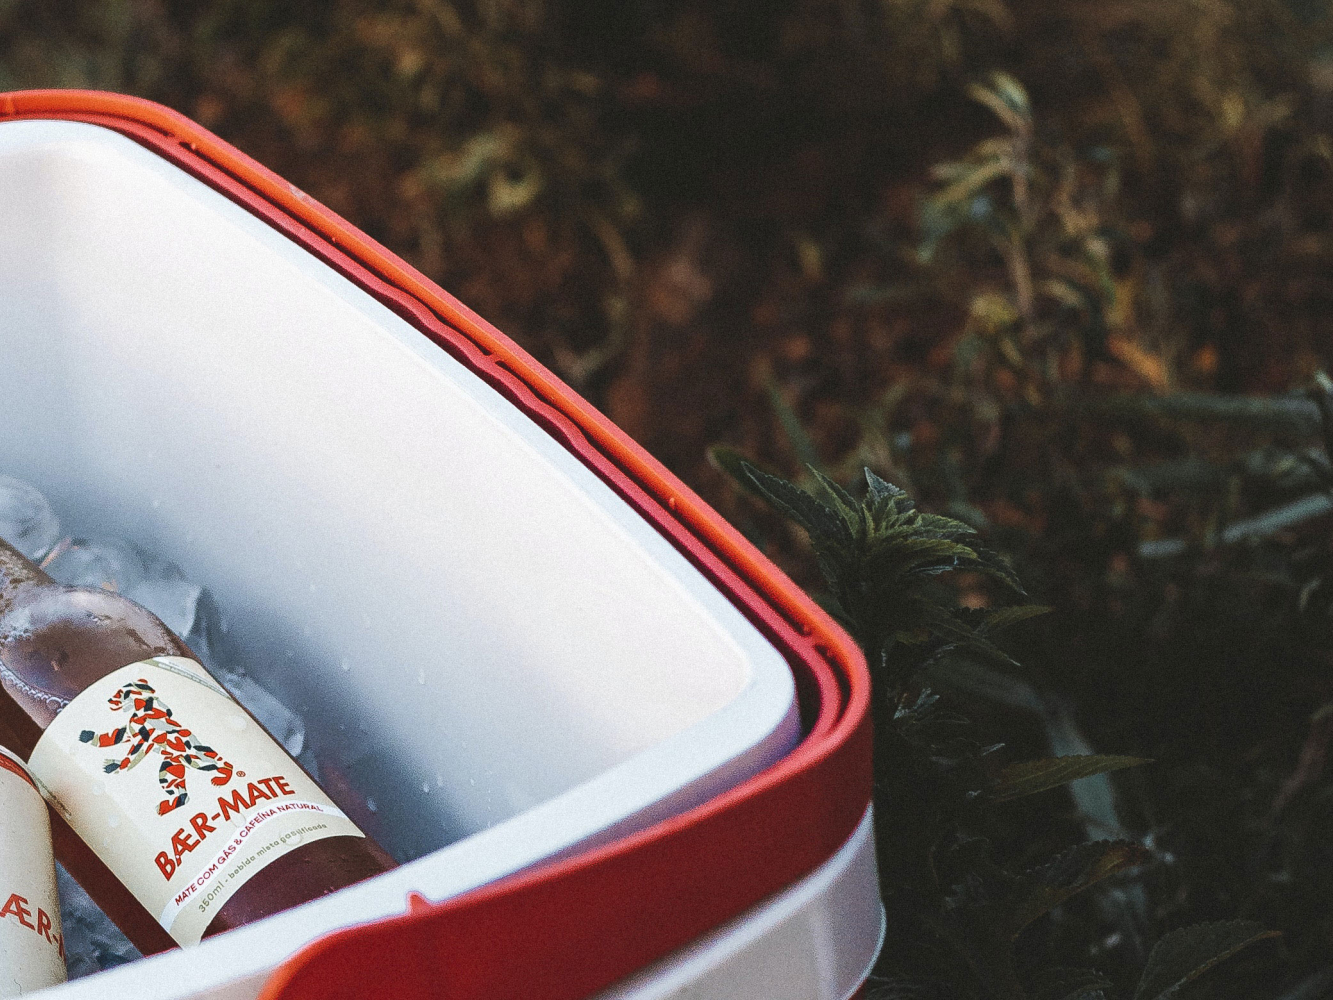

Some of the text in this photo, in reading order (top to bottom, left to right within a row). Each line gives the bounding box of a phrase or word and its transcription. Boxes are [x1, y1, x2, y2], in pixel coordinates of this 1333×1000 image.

[154, 776, 295, 881] BÆR-MATE
[174, 883, 197, 906] MATE
[197, 864, 218, 886] COM
[217, 844, 236, 865] GÁS
[239, 808, 277, 838] CAFEÍNA
[276, 802, 324, 813] NATURAL
[198, 880, 225, 913] 350ml
[228, 855, 256, 879] bebida
[256, 839, 280, 857] mista
